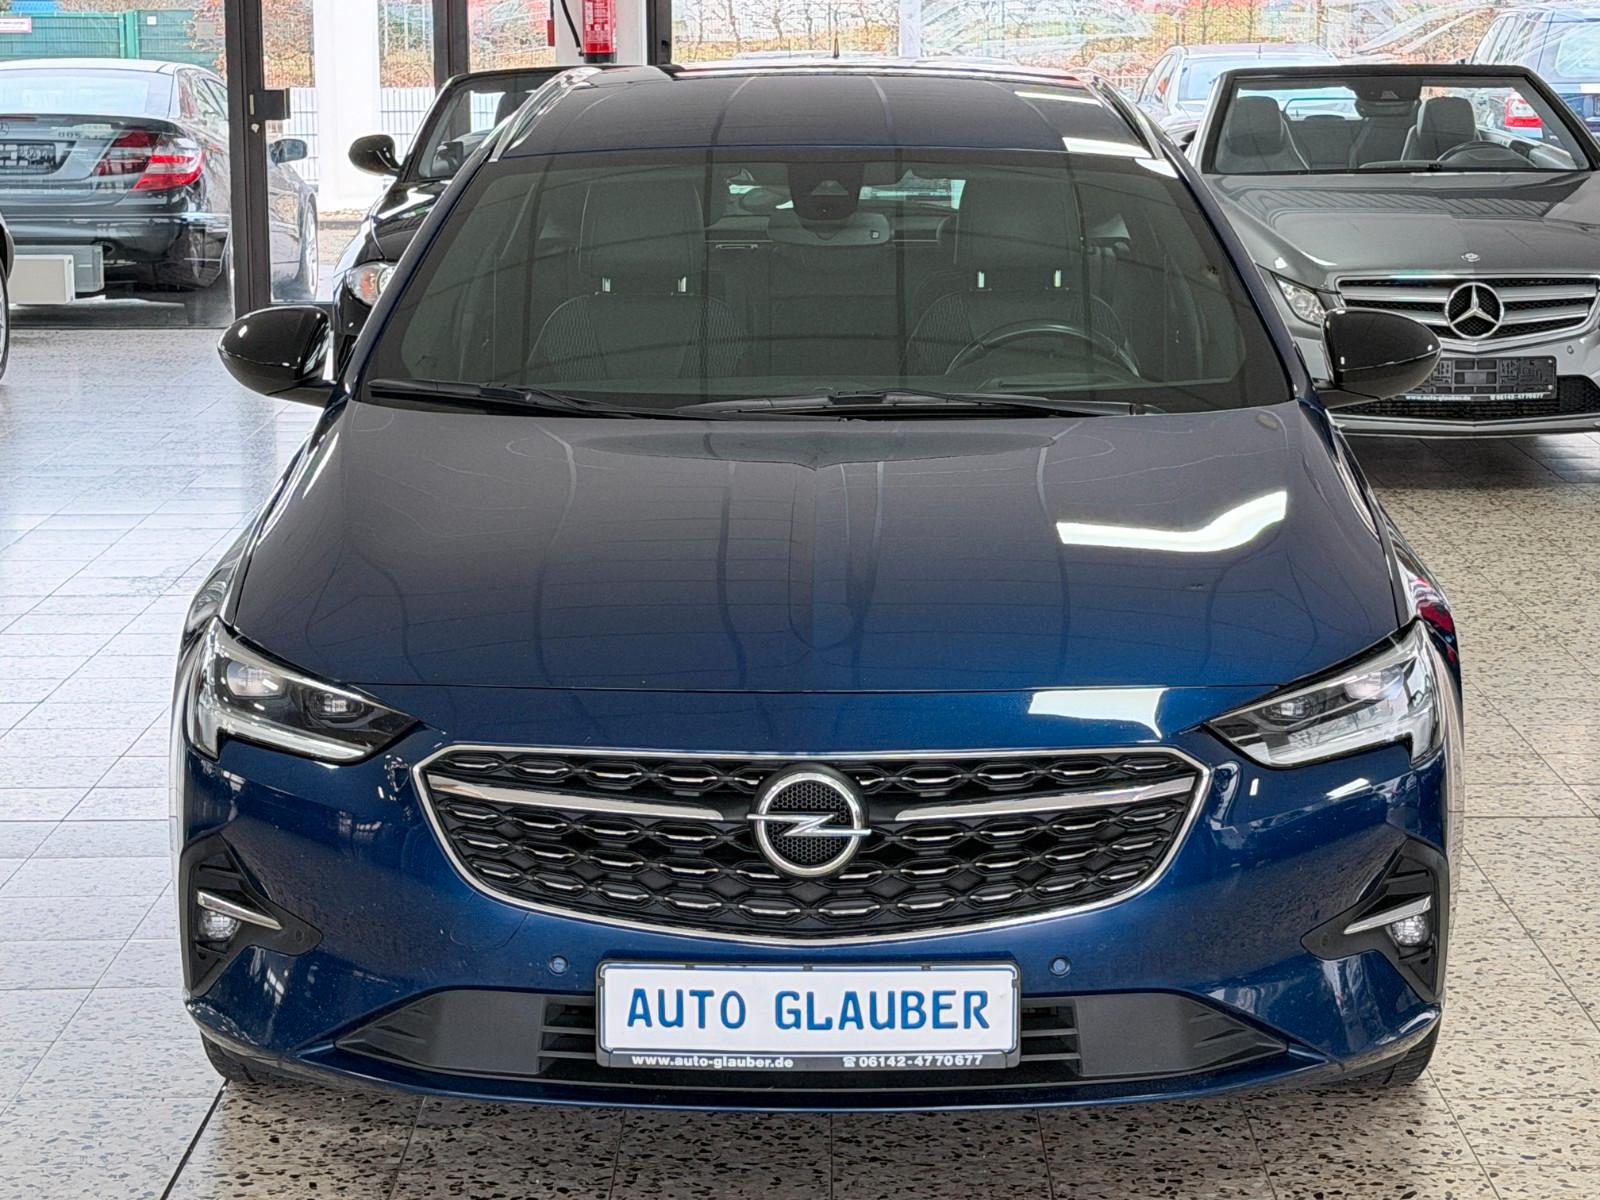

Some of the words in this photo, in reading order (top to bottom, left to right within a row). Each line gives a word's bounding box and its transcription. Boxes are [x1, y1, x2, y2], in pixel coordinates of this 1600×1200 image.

[626, 988, 747, 1030] AUTO
[775, 989, 990, 1031] GLAUBER
[631, 1055, 794, 1069] www.auto-glauber.de
[859, 1054, 984, 1068] 06142-4770677
